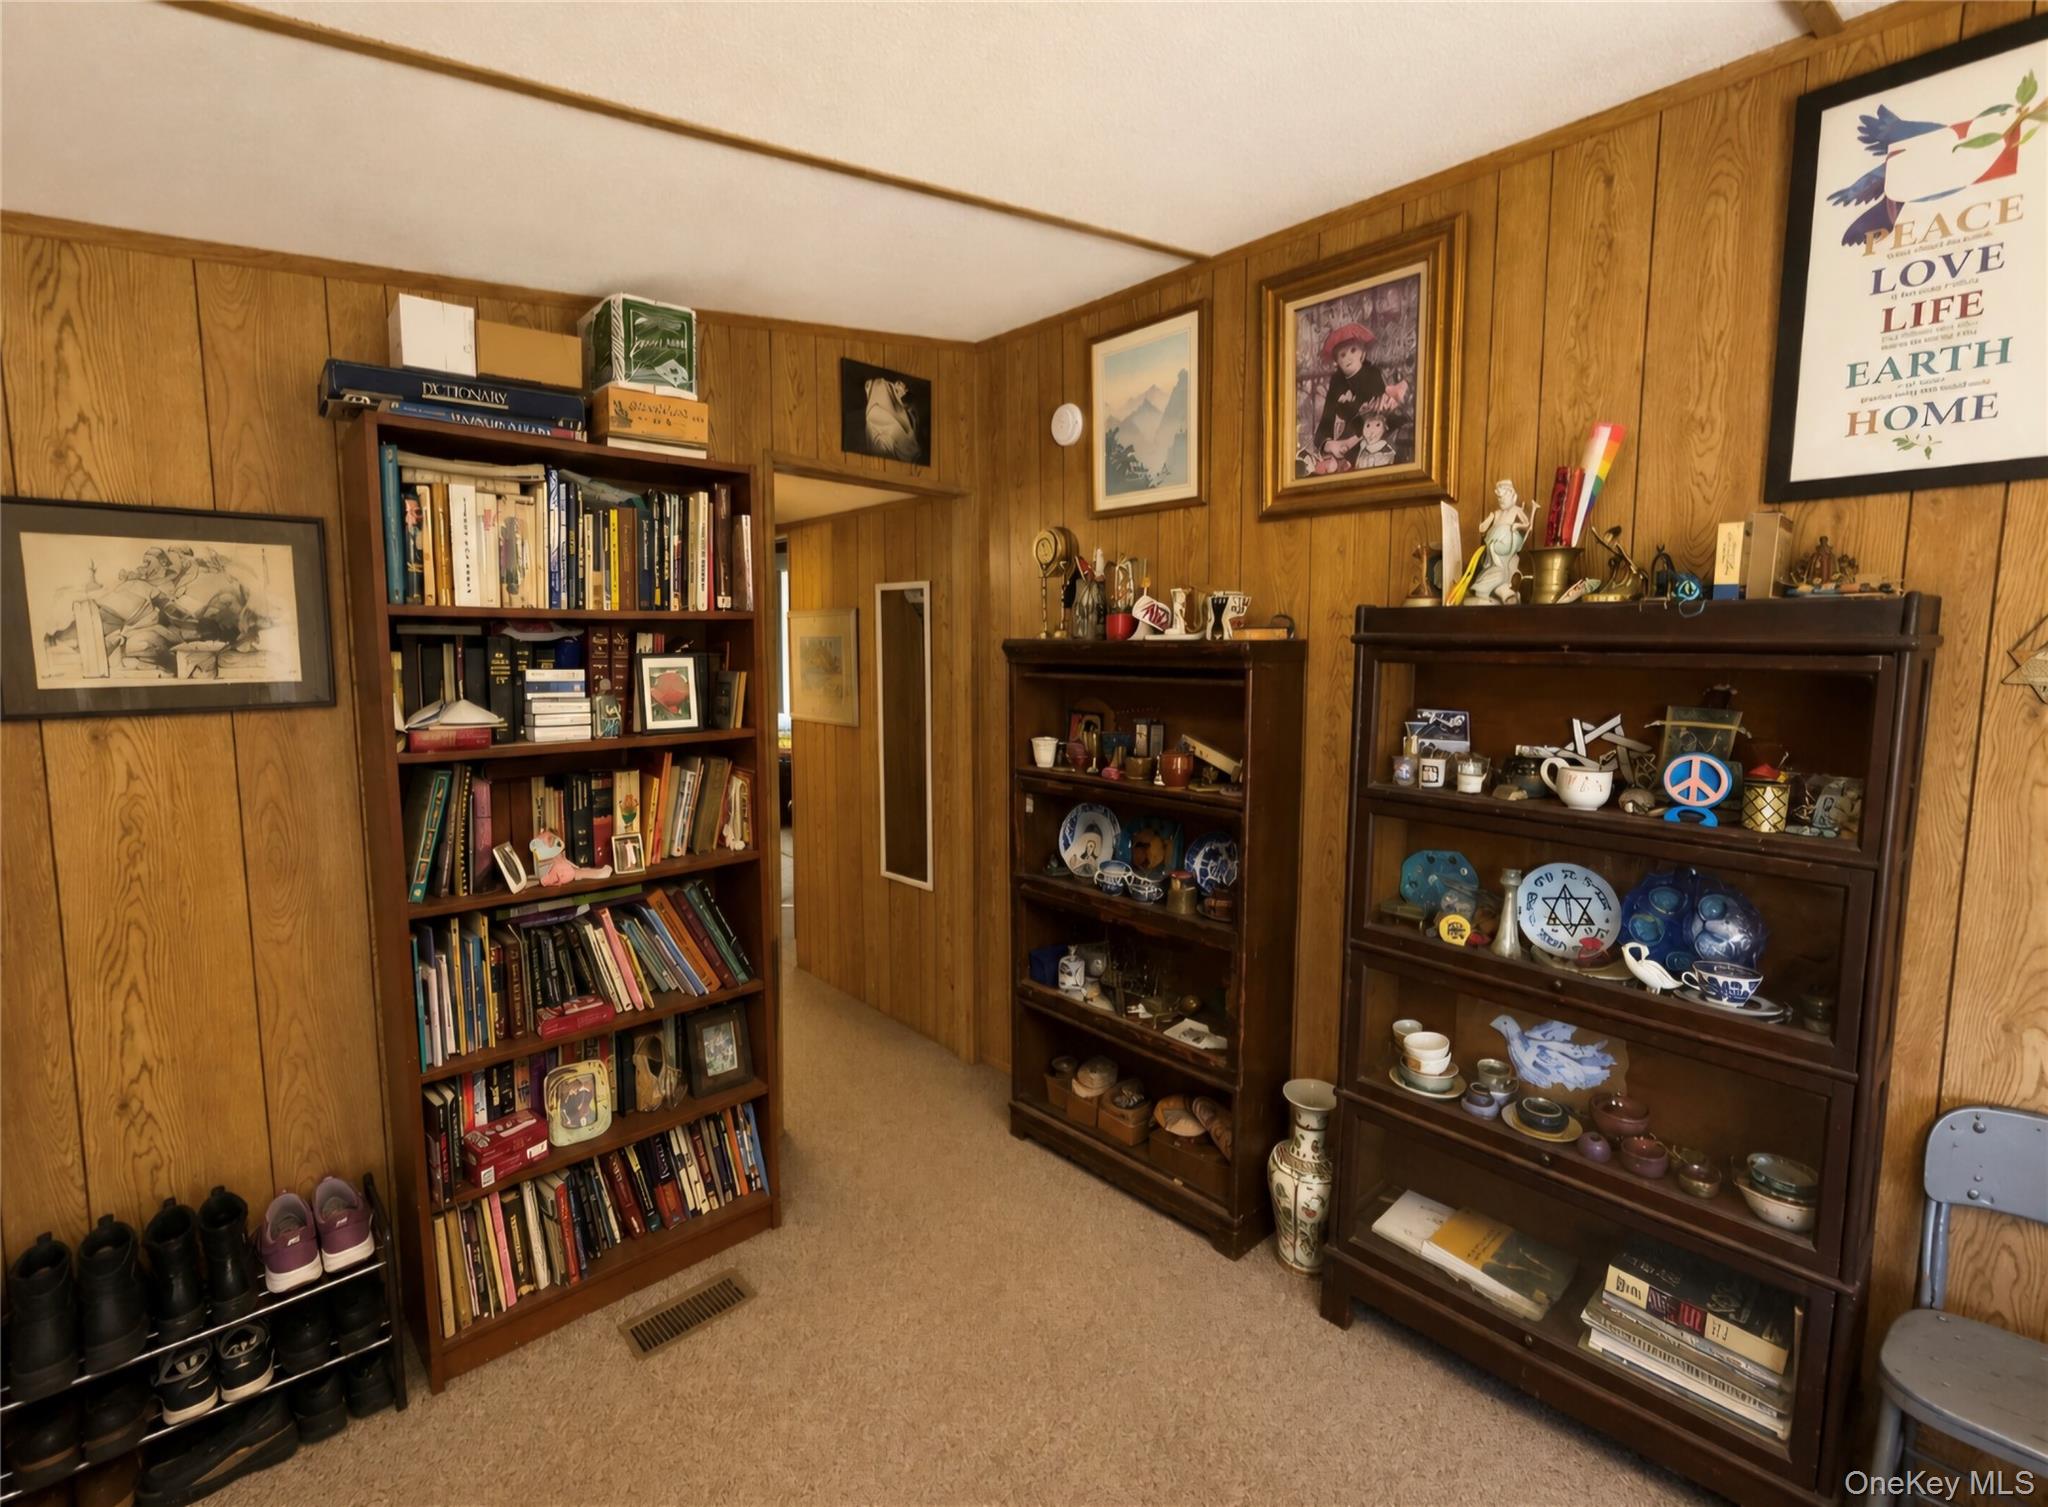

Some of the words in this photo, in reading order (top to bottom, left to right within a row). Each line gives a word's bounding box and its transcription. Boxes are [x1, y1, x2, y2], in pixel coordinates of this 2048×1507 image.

[1862, 194, 2025, 257] PEACE
[1869, 241, 2005, 296] LOVE
[1880, 289, 1985, 334] LIFE
[1845, 336, 2014, 389] EARTH
[1845, 392, 1999, 438] HOME
